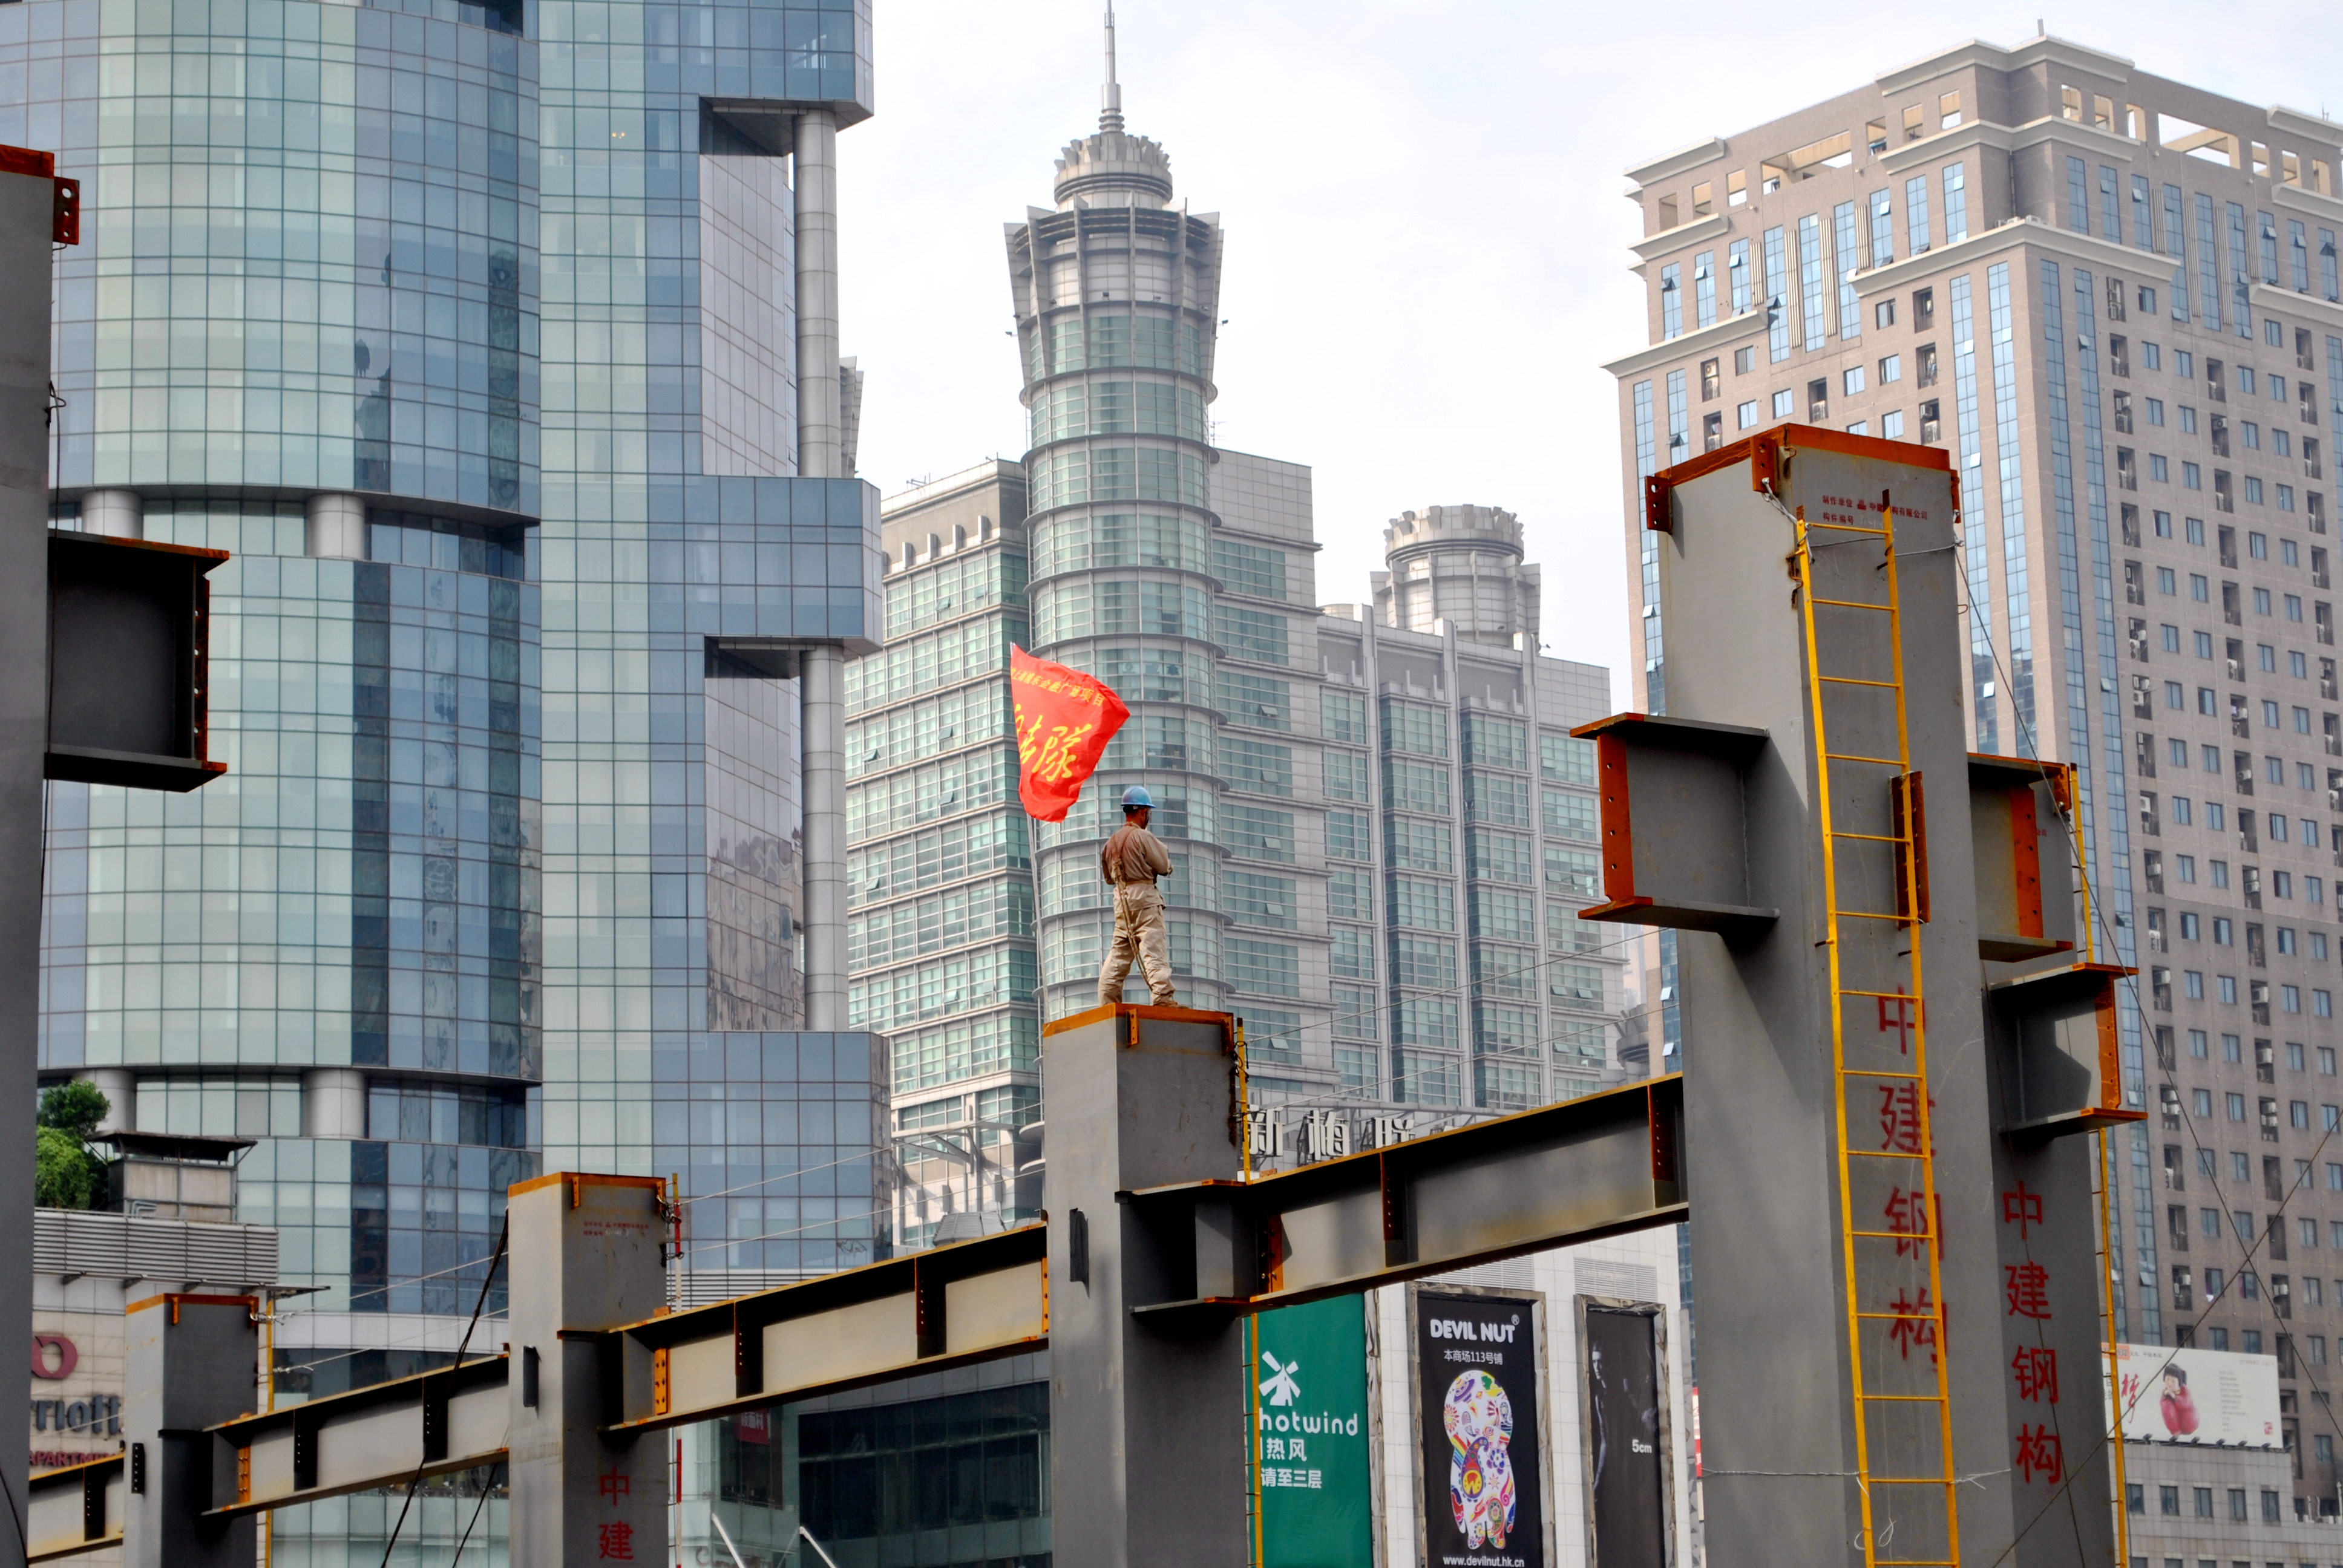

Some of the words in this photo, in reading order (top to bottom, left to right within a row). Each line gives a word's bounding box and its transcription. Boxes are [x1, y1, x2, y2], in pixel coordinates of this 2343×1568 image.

[1869, 501, 1928, 520] 中建构有限公司
[1878, 984, 1947, 1364] 中建钢构
[1430, 1319, 1477, 1341] DEVIL
[1480, 1322, 1516, 1344] NUT
[2003, 1180, 2061, 1485] 中建钢构
[1444, 1349, 1503, 1365] 本商场113号铺
[30, 1394, 120, 1435] riott
[1259, 1408, 1358, 1436] hotwind
[1266, 1437, 1308, 1462] 热风
[1632, 1439, 1653, 1454] 5cm
[1260, 1468, 1322, 1489] 请至三层
[599, 1466, 634, 1561] 中建
[1442, 1555, 1525, 1567] www.devilnut.hk.cn
